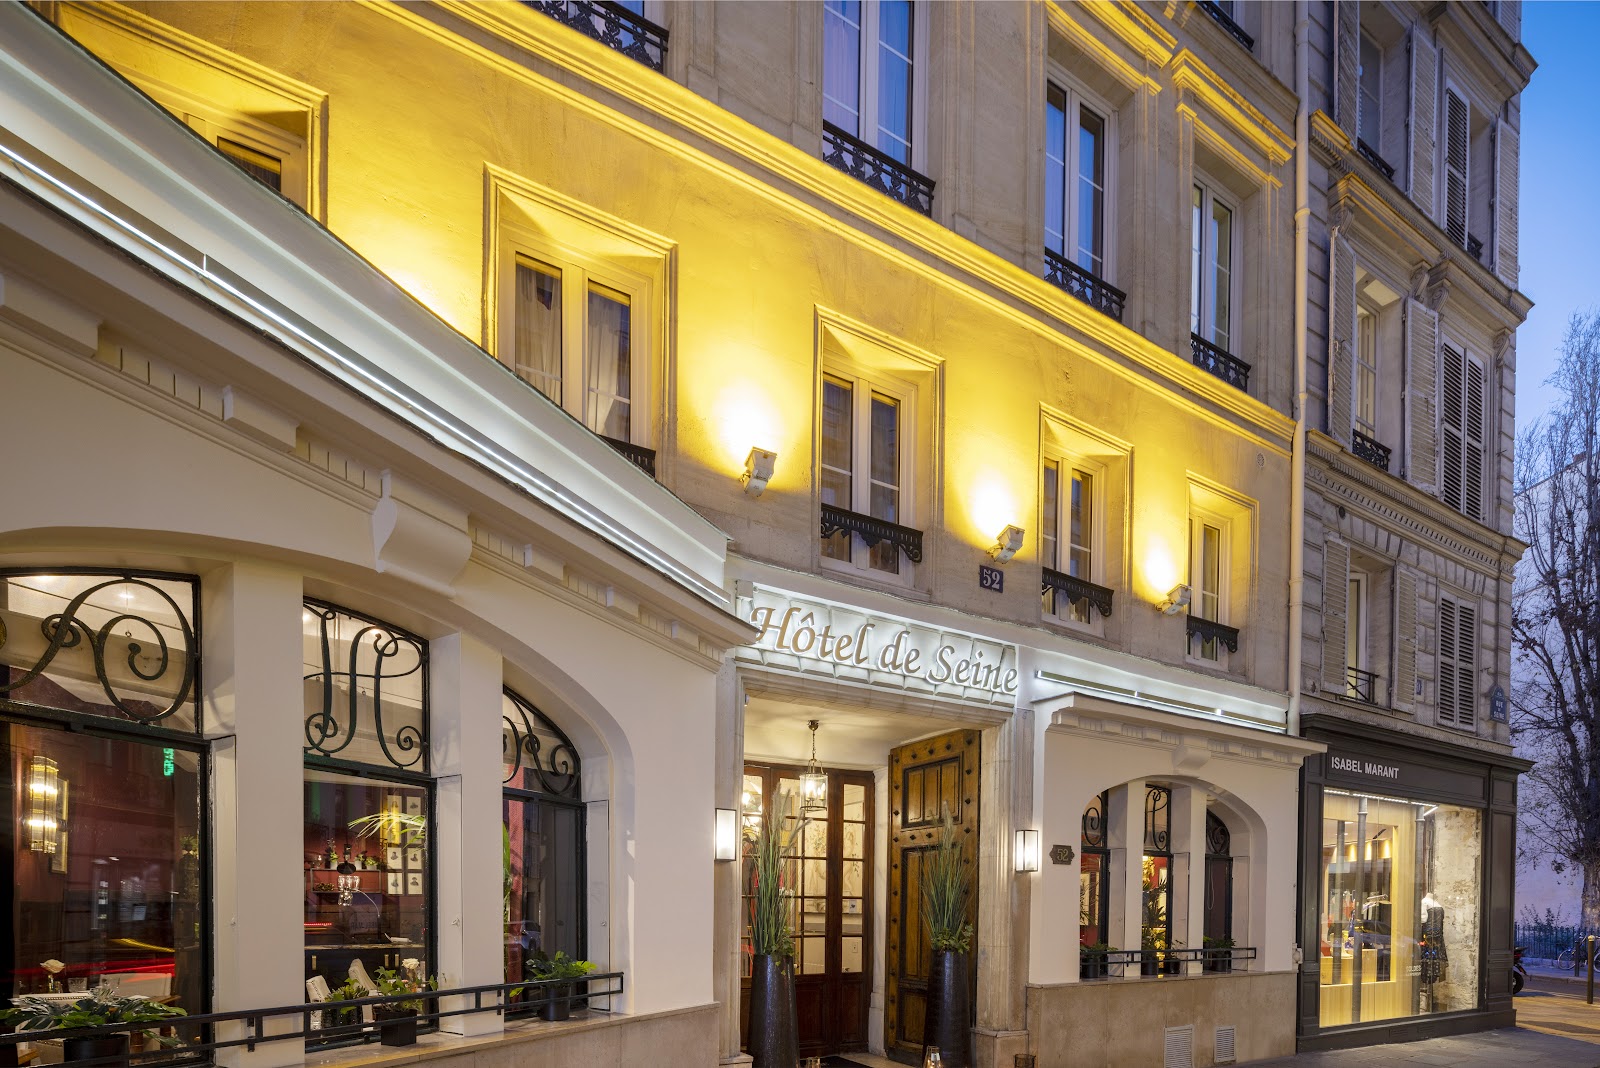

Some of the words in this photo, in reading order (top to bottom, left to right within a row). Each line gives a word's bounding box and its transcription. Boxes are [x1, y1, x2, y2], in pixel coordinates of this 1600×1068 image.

[982, 568, 1001, 590] 52
[750, 606, 876, 666] Hôtel
[878, 630, 921, 674] de
[926, 645, 1018, 693] Seine
[1331, 756, 1362, 773] ISABEL
[1364, 762, 1399, 779] MARANT
[1057, 848, 1069, 861] 52
